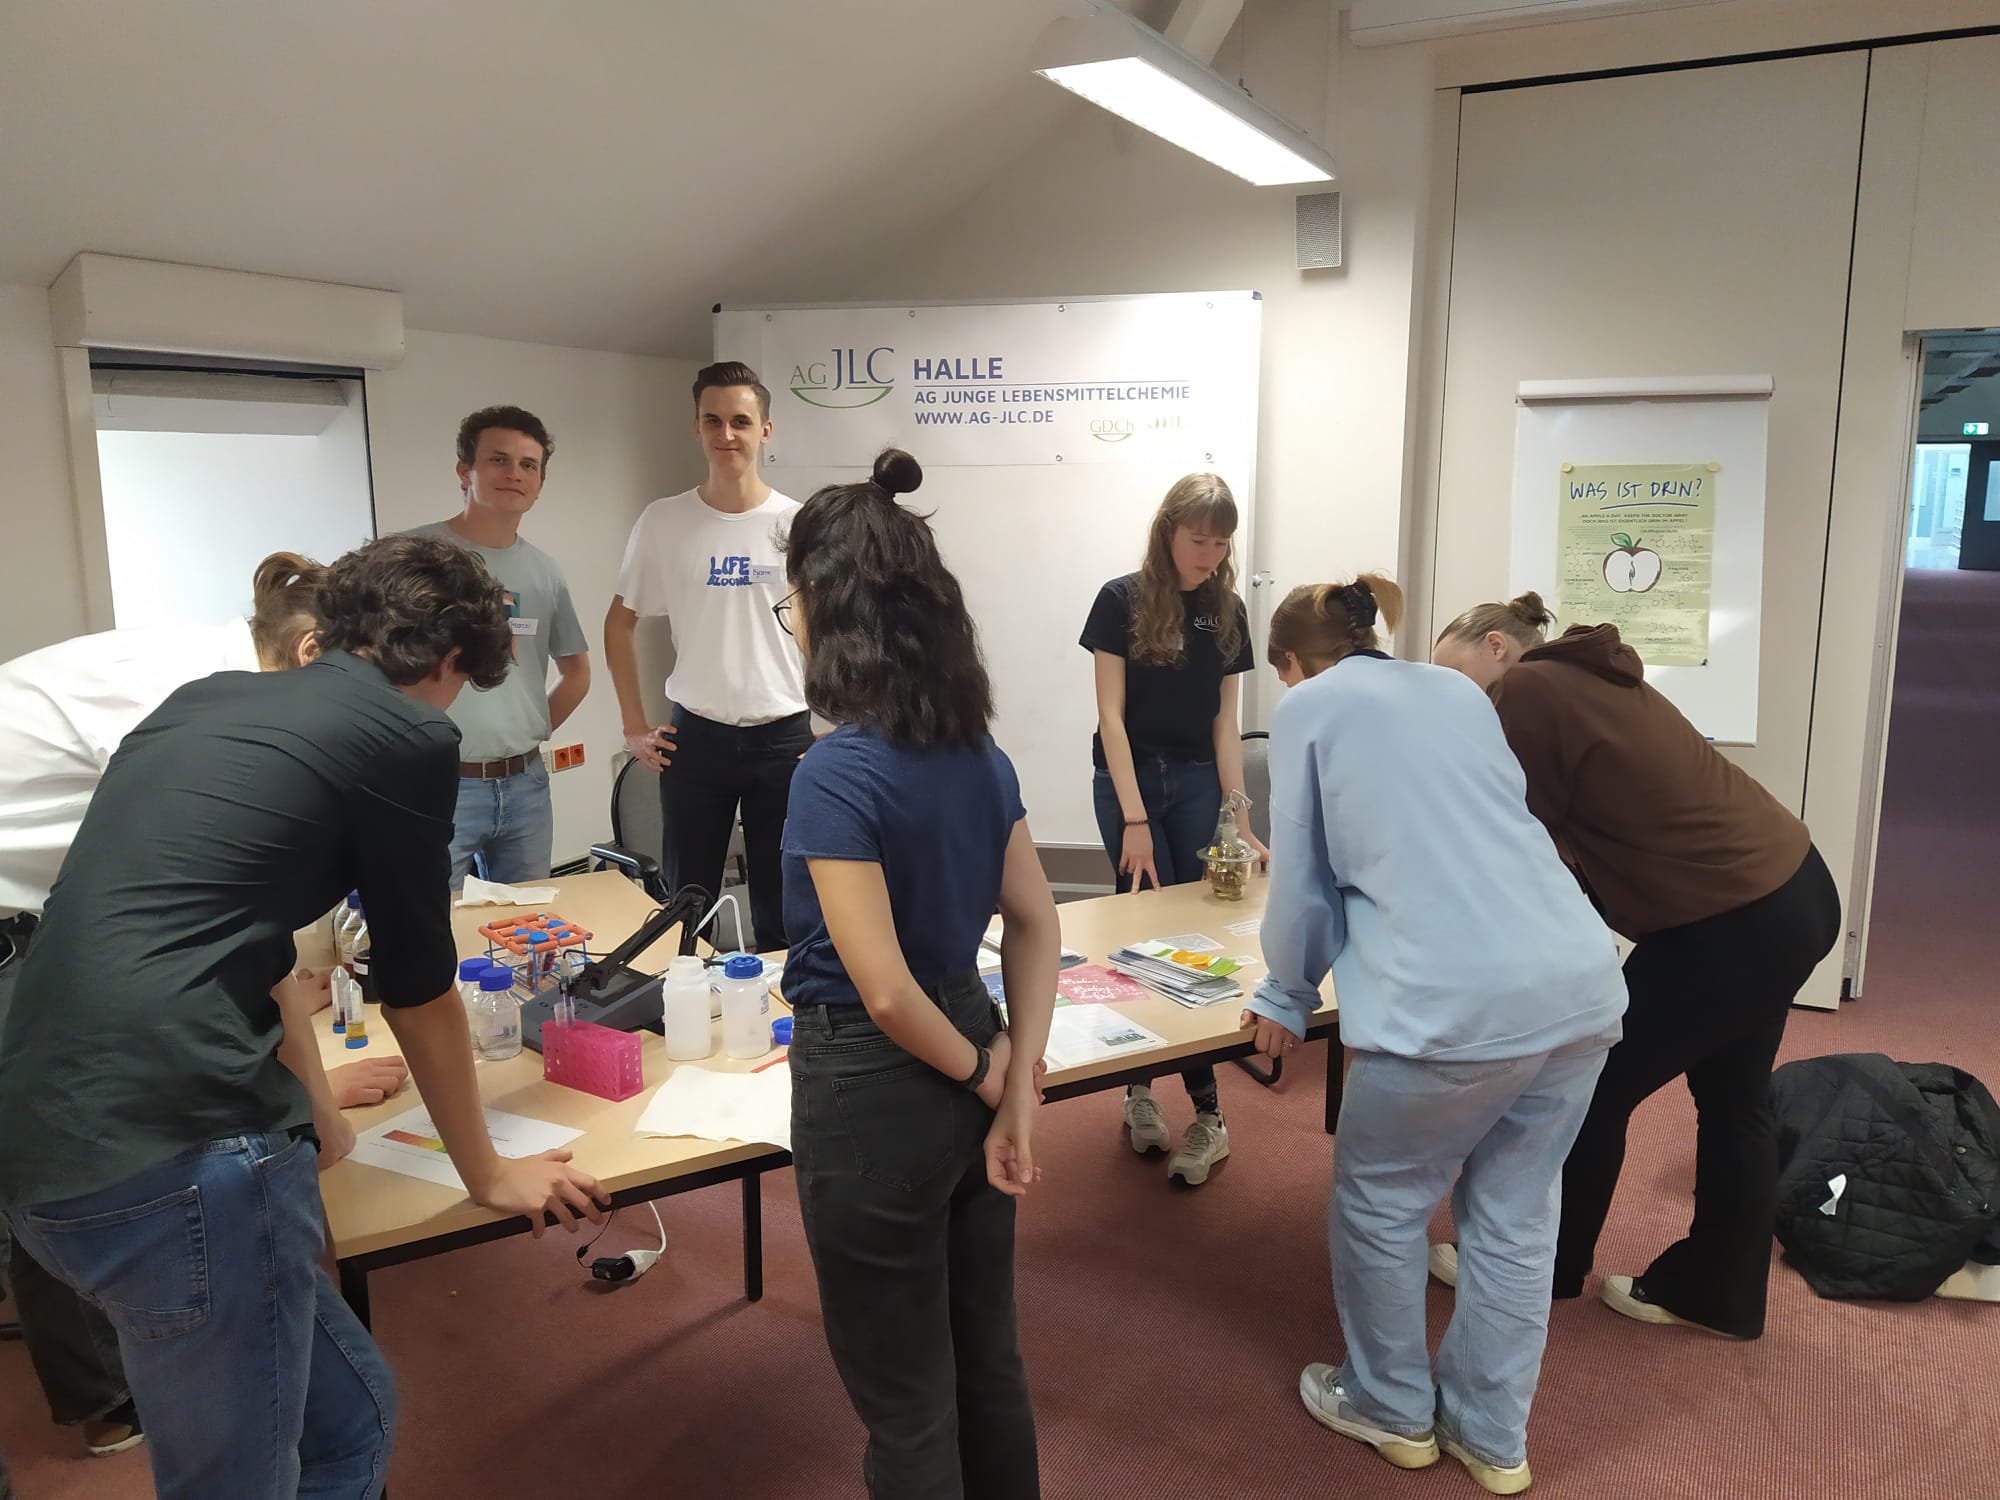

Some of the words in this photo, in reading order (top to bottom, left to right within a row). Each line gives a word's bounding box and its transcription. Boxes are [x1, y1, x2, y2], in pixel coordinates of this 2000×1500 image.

[789, 363, 827, 385] AG
[832, 347, 895, 391] JLC
[914, 357, 1003, 380] HALLE
[915, 391, 937, 404] AG
[943, 389, 996, 403] JUNGE
[1002, 386, 1190, 402] LEBENSMITTELCHEMIE
[915, 411, 1054, 425] WWW.AG-JLC.DE
[1570, 481, 1608, 500] WAS
[1617, 481, 1643, 498] IST
[1650, 478, 1702, 498] DRIN?
[710, 556, 751, 575] LIFE
